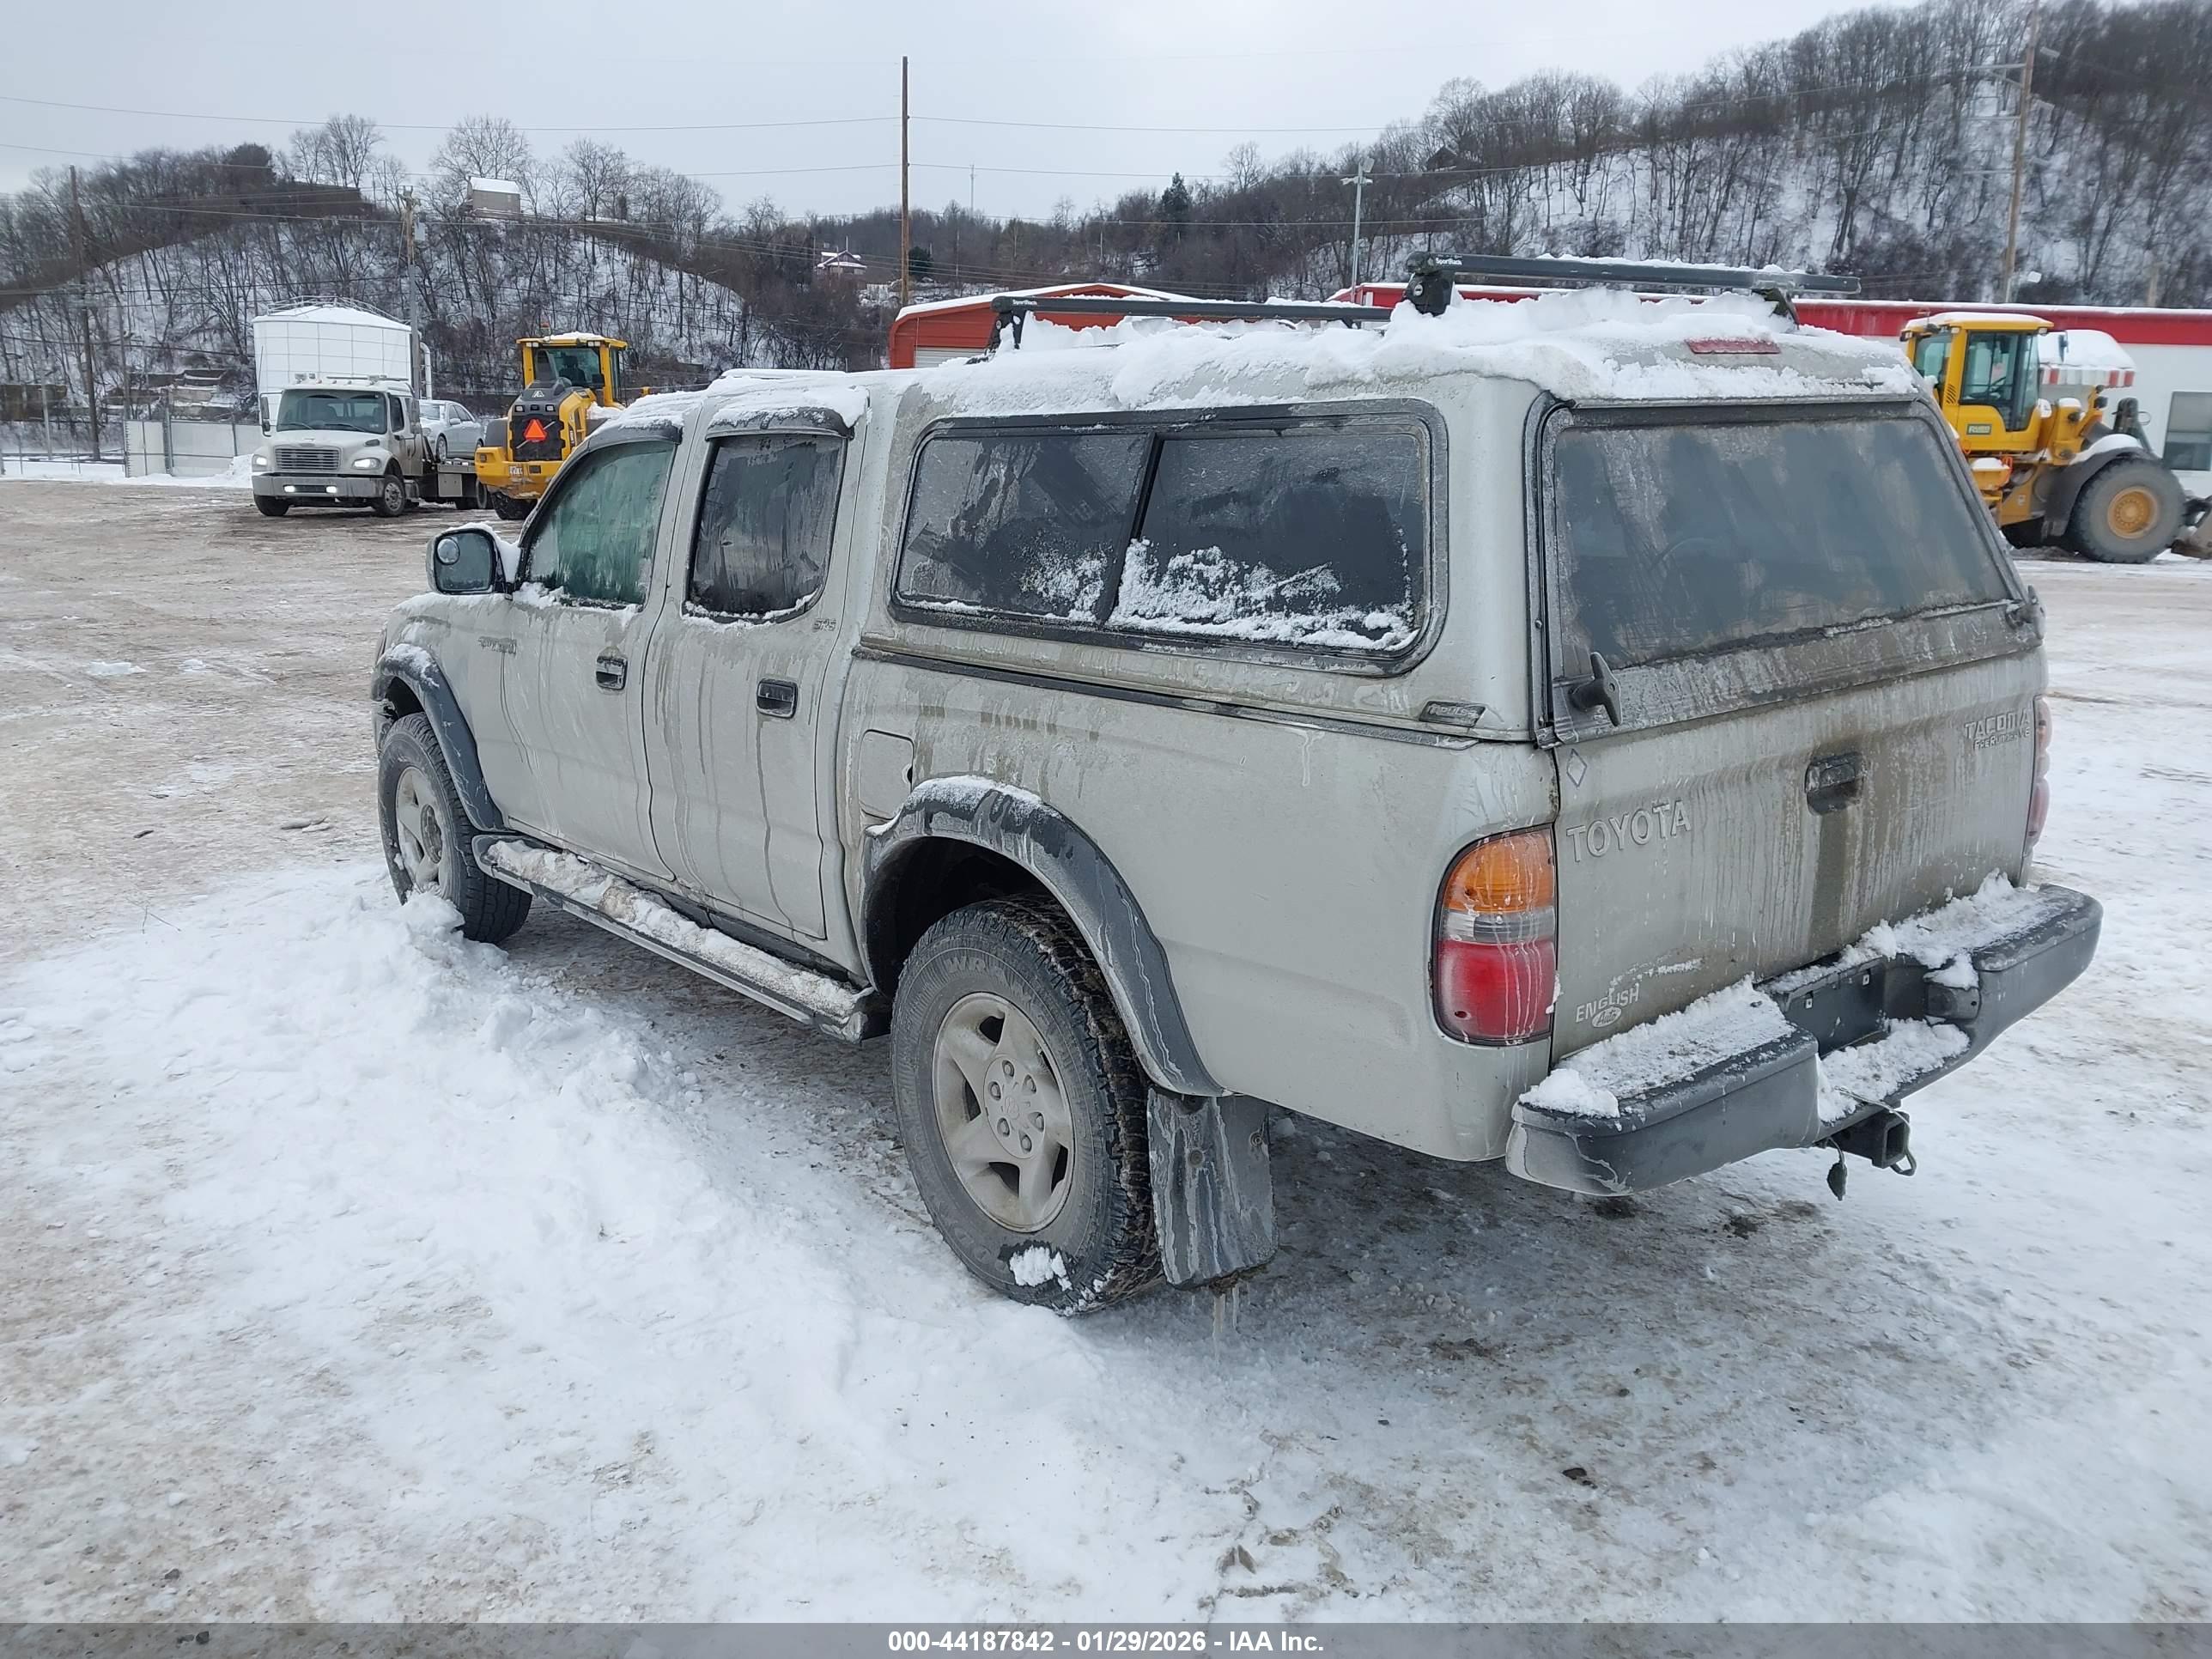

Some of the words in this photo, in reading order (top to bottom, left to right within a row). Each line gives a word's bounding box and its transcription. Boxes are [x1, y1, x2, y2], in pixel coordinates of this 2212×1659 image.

[1964, 708, 2031, 739] TACOMA
[1565, 799, 1691, 863] TOYOTA
[1575, 982, 1640, 1023] ENGLISH
